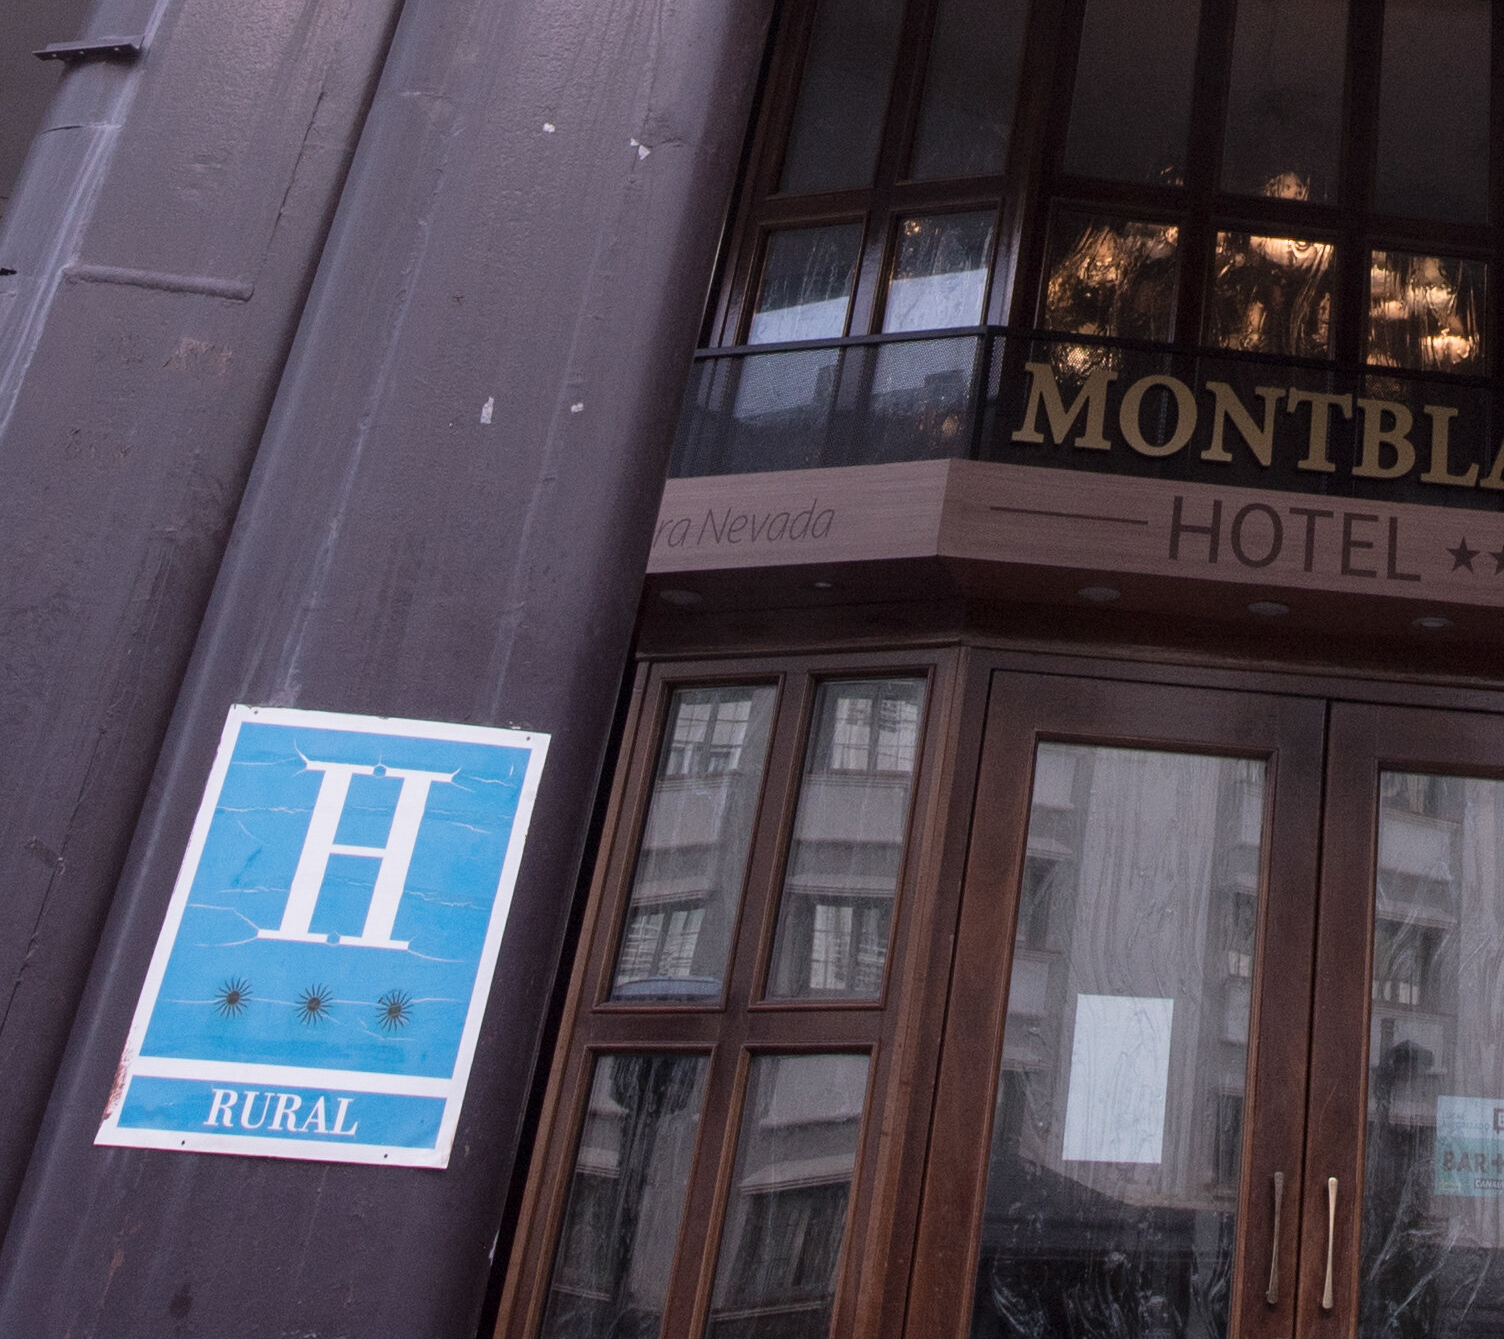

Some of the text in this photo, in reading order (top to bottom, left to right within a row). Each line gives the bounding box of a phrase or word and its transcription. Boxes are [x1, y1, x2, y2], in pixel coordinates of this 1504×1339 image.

[697, 498, 836, 544] Nevada
[1168, 495, 1422, 582] HOTEL
[257, 759, 453, 951] H
[202, 1088, 359, 1136] RURAL
